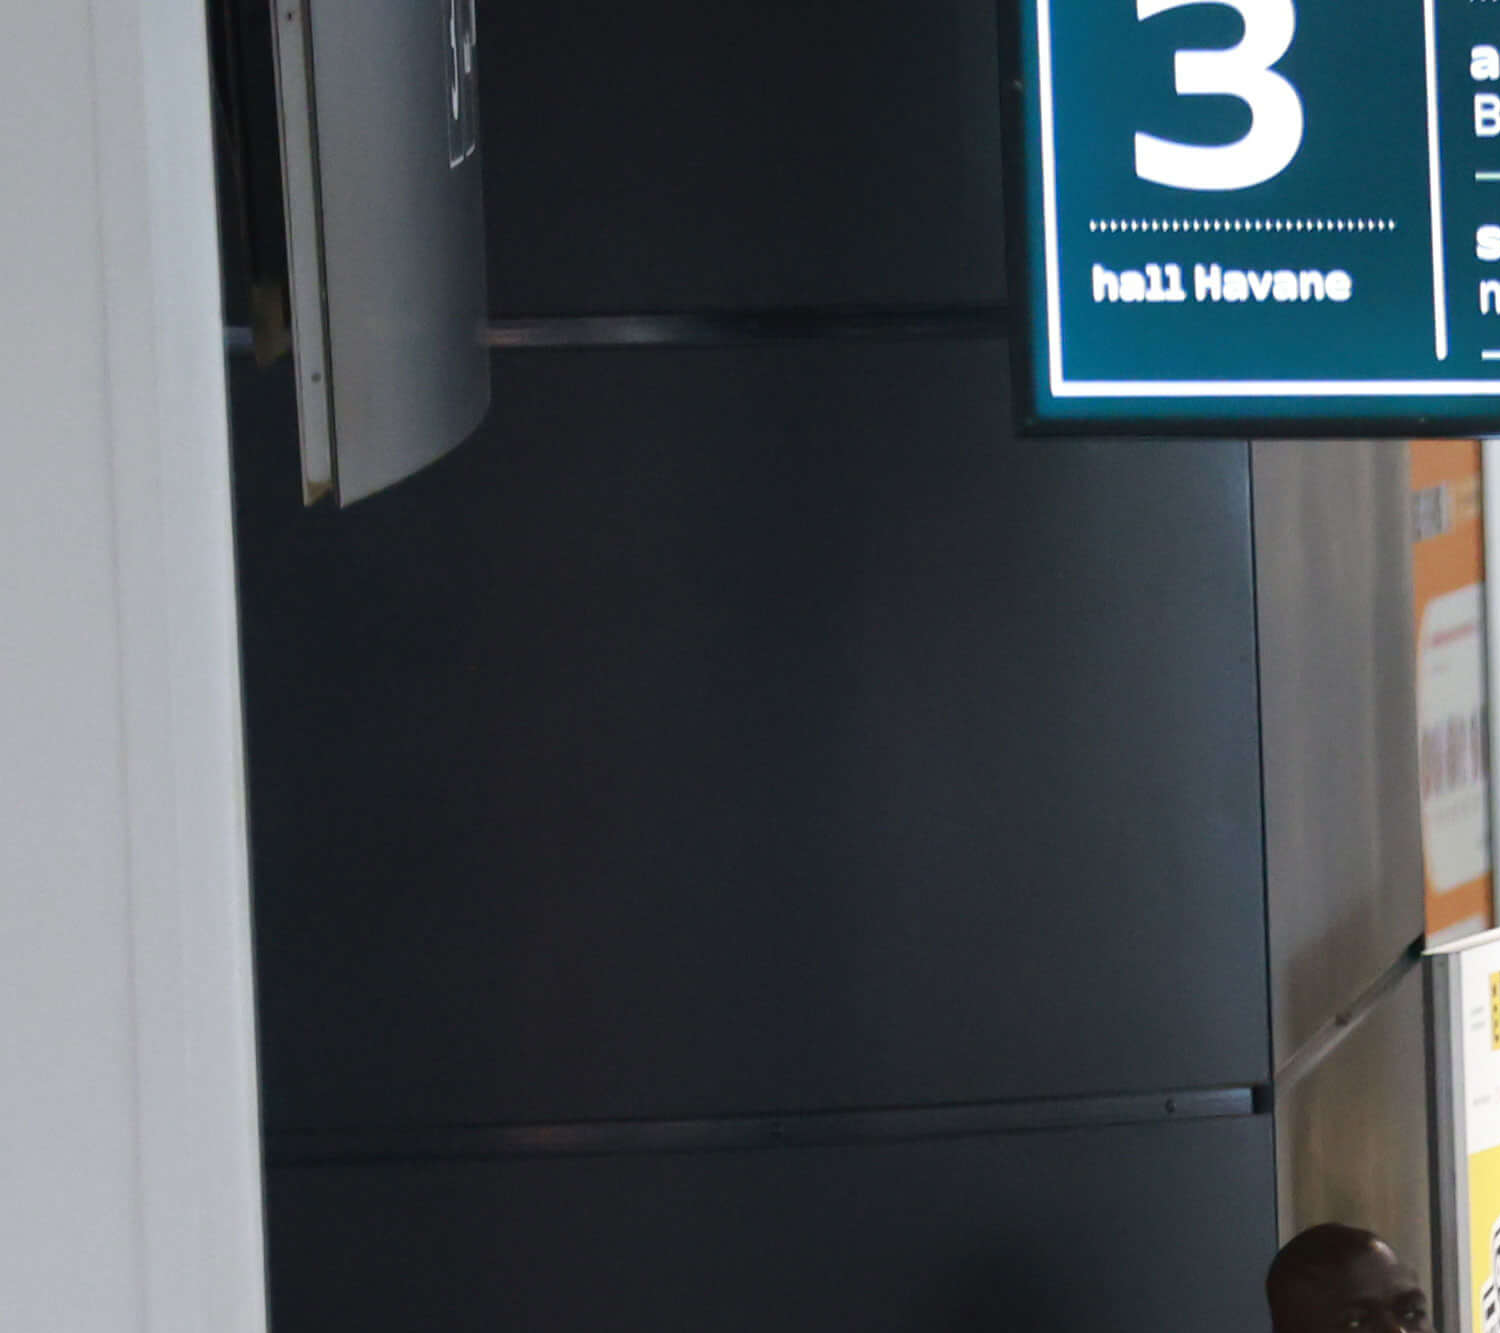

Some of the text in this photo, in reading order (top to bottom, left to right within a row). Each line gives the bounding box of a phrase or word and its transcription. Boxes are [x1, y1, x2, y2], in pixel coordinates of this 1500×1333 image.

[1135, 0, 1304, 191] 3
[1091, 262, 1353, 303] hall Havane
